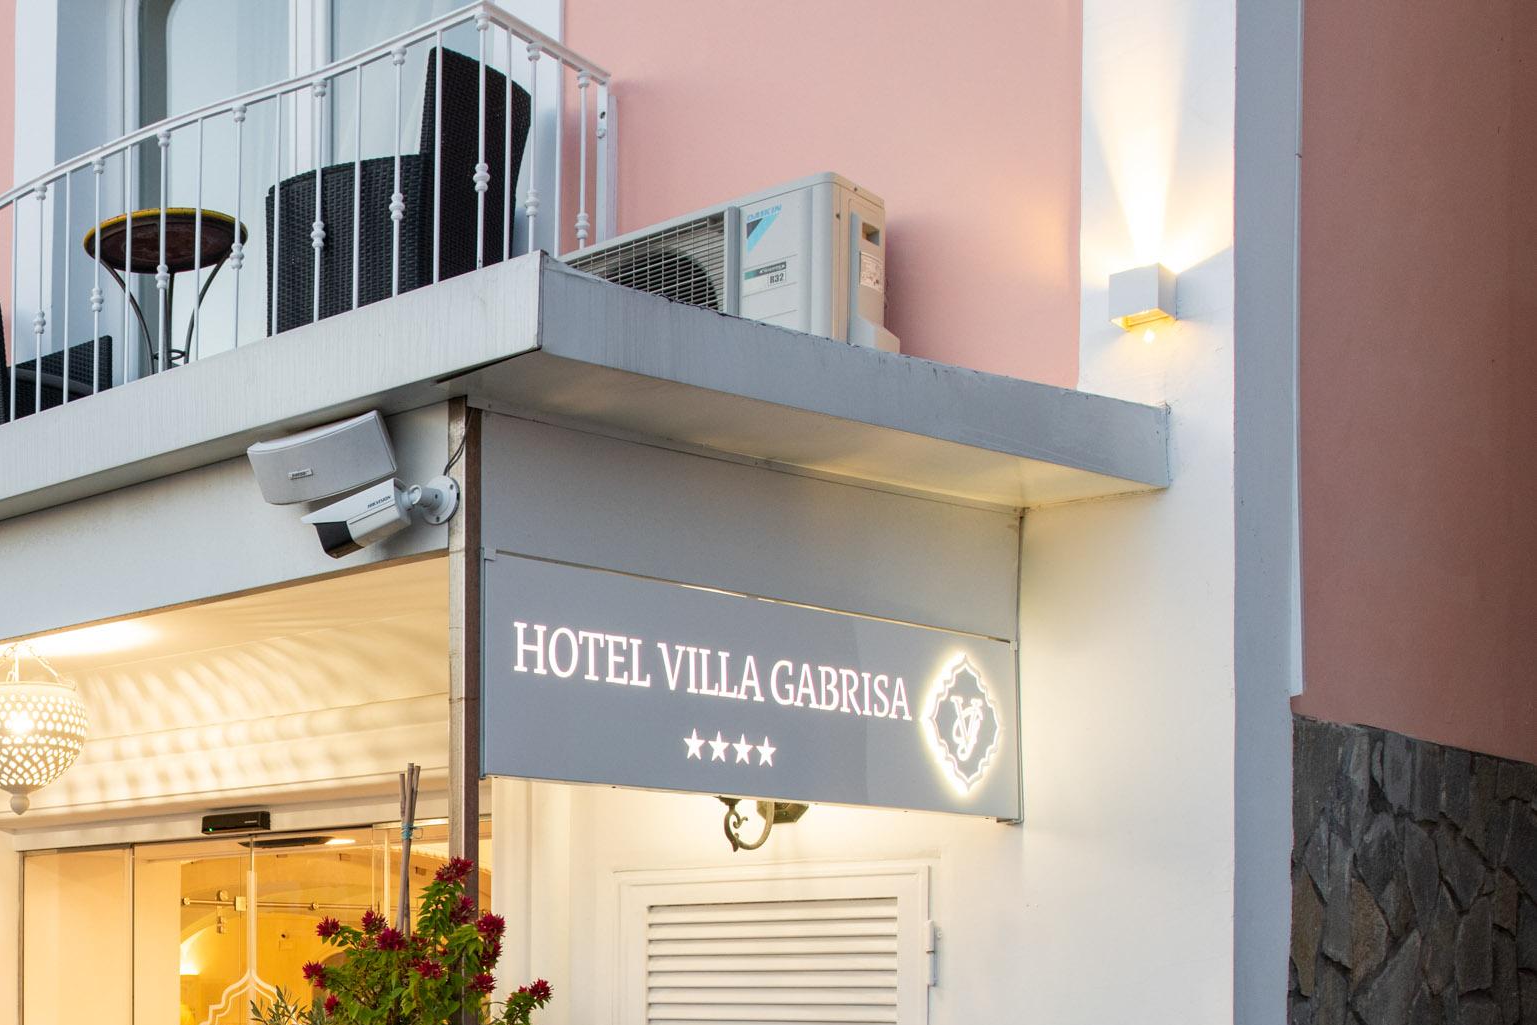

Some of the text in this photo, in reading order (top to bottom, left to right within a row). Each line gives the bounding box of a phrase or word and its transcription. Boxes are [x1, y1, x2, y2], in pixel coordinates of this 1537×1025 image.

[770, 273, 784, 284] R32
[367, 495, 392, 509] HIKVISION
[513, 622, 913, 722] HOTEL VILLA GABRISA
